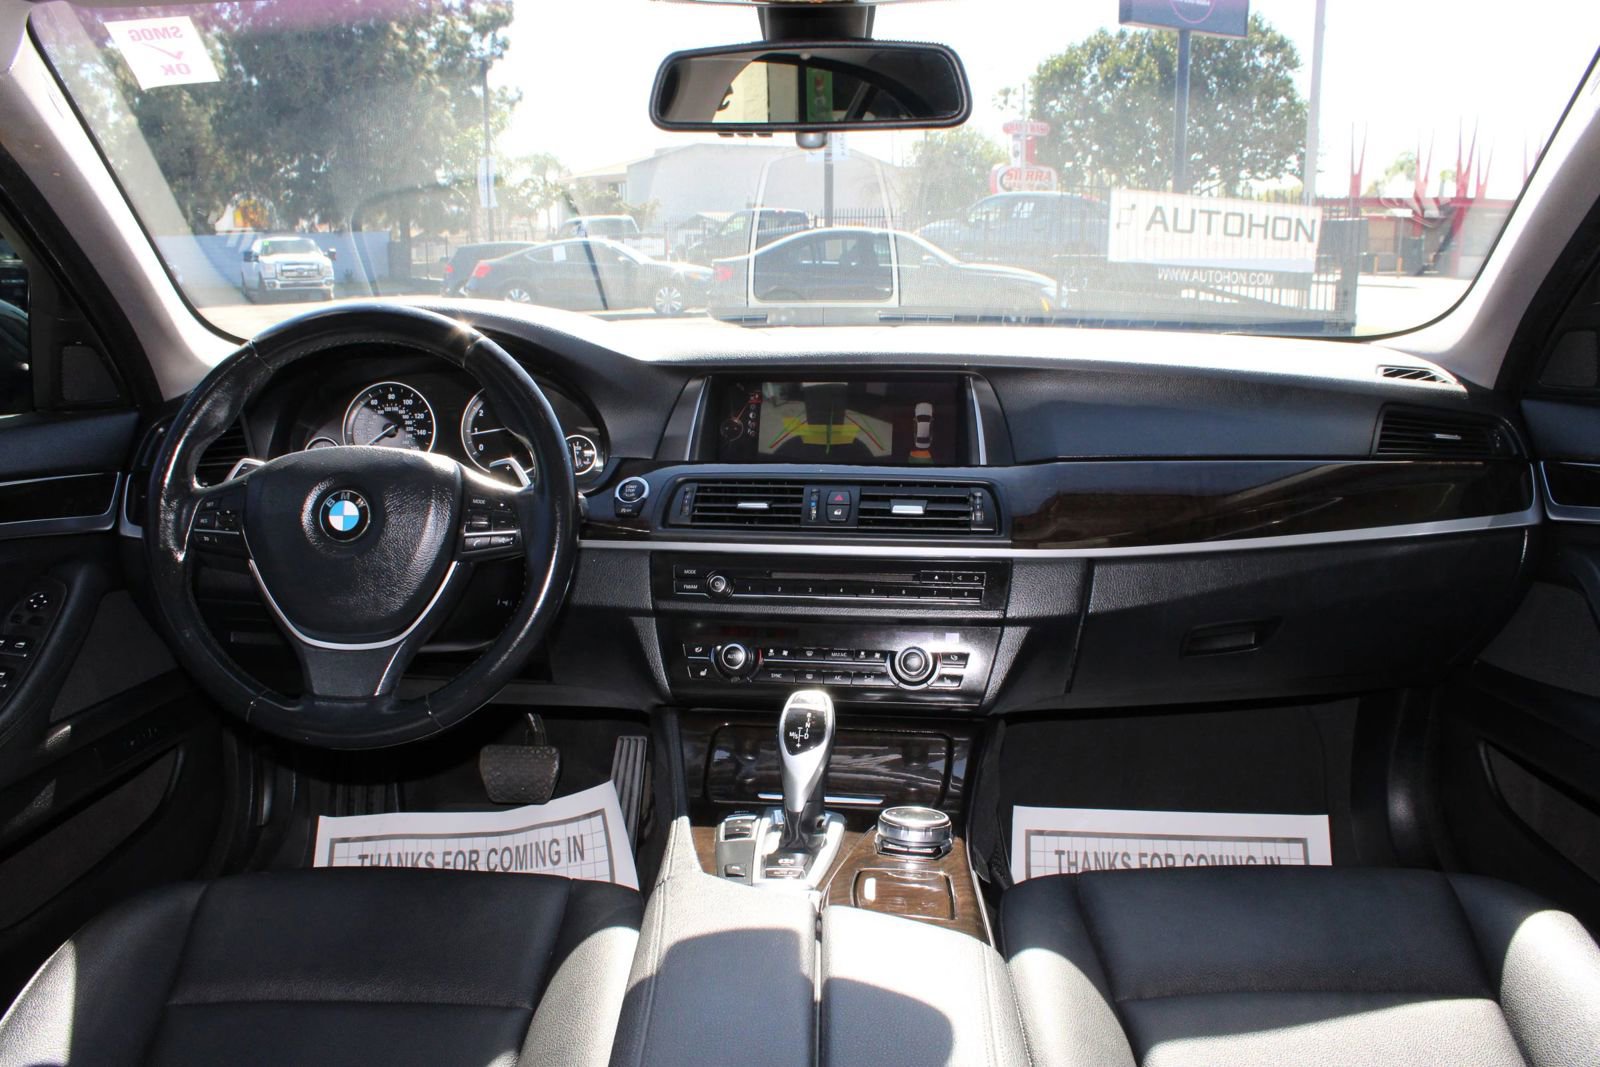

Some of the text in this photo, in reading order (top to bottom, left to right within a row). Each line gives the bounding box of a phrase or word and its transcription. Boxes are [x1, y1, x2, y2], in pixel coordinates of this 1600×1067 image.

[1145, 205, 1317, 243] AUTOHON
[1157, 267, 1274, 286] WWW.AUTOHON.COM
[325, 492, 367, 508] BMW
[358, 834, 586, 872] THANKS FOR COMING IN
[1055, 850, 1131, 874] THANKS
[1139, 853, 1177, 868] FOR
